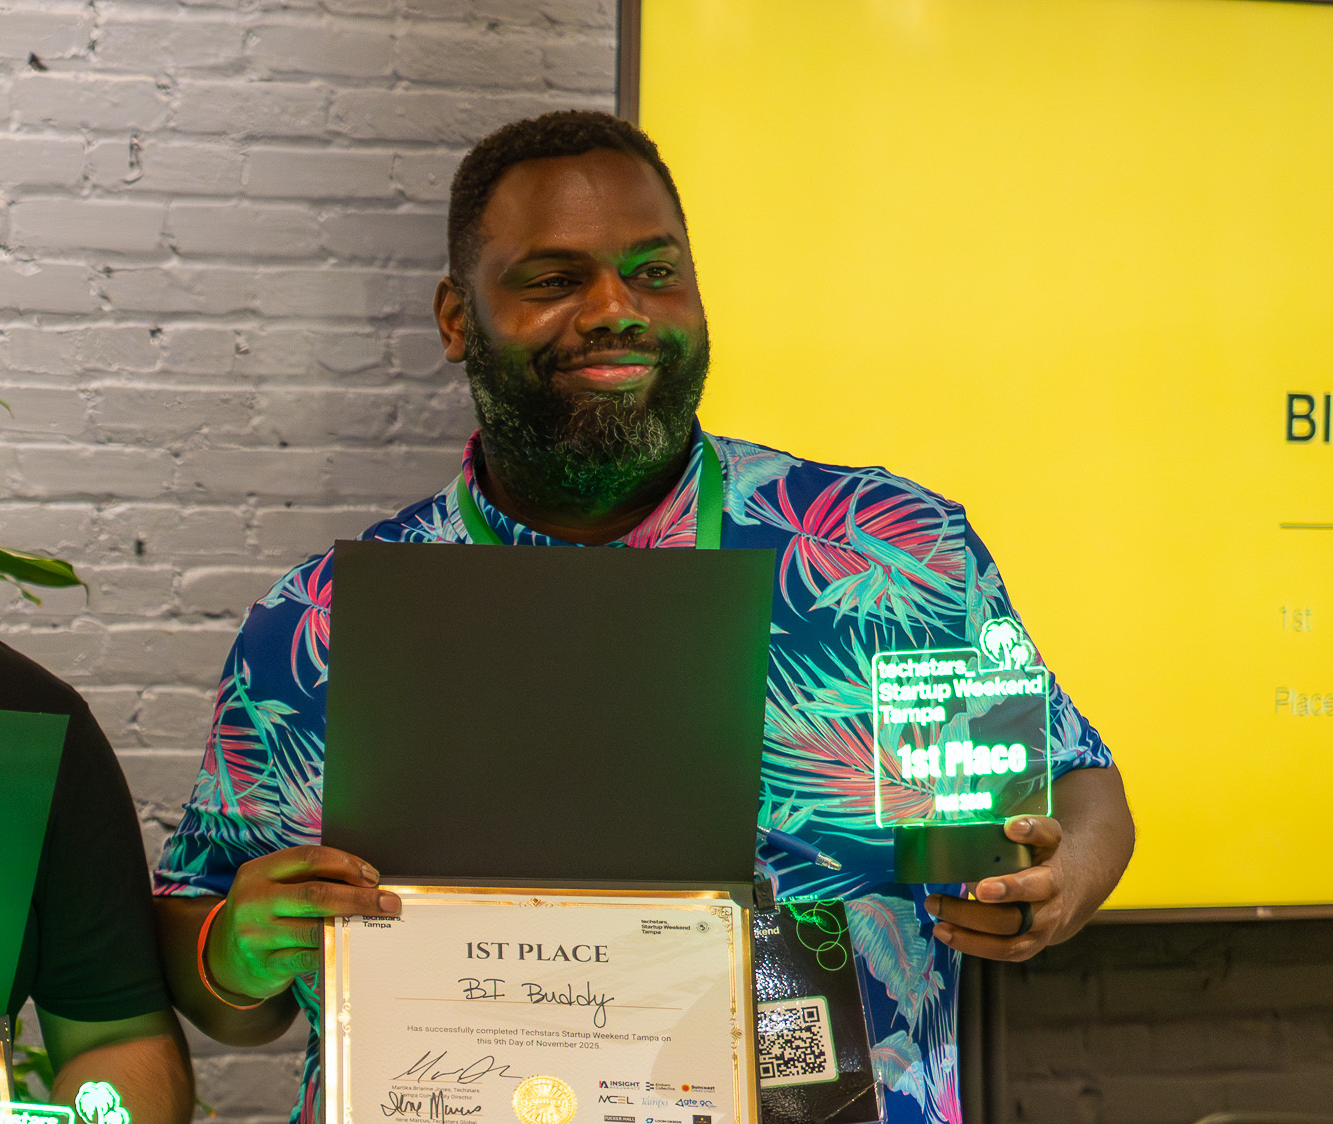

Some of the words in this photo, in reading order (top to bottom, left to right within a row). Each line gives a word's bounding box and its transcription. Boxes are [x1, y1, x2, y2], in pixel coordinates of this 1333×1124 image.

[1279, 604, 1312, 632] 1st
[878, 681, 951, 702] Startup
[953, 675, 1043, 698] Weekend
[878, 704, 946, 726] Tampa
[897, 743, 941, 779] 1st
[945, 740, 1027, 777] Place
[362, 921, 392, 929] Tampa
[465, 941, 509, 960] 1ST
[517, 943, 610, 963] PLACE
[458, 978, 505, 1000] BI
[521, 981, 615, 1028] Buddy
[424, 1026, 474, 1035] successfully
[475, 1027, 518, 1038] completed
[520, 1028, 560, 1037] Techstars
[561, 1030, 591, 1039] Startup
[592, 1032, 629, 1040] Weekend
[631, 1033, 659, 1042] Tampa
